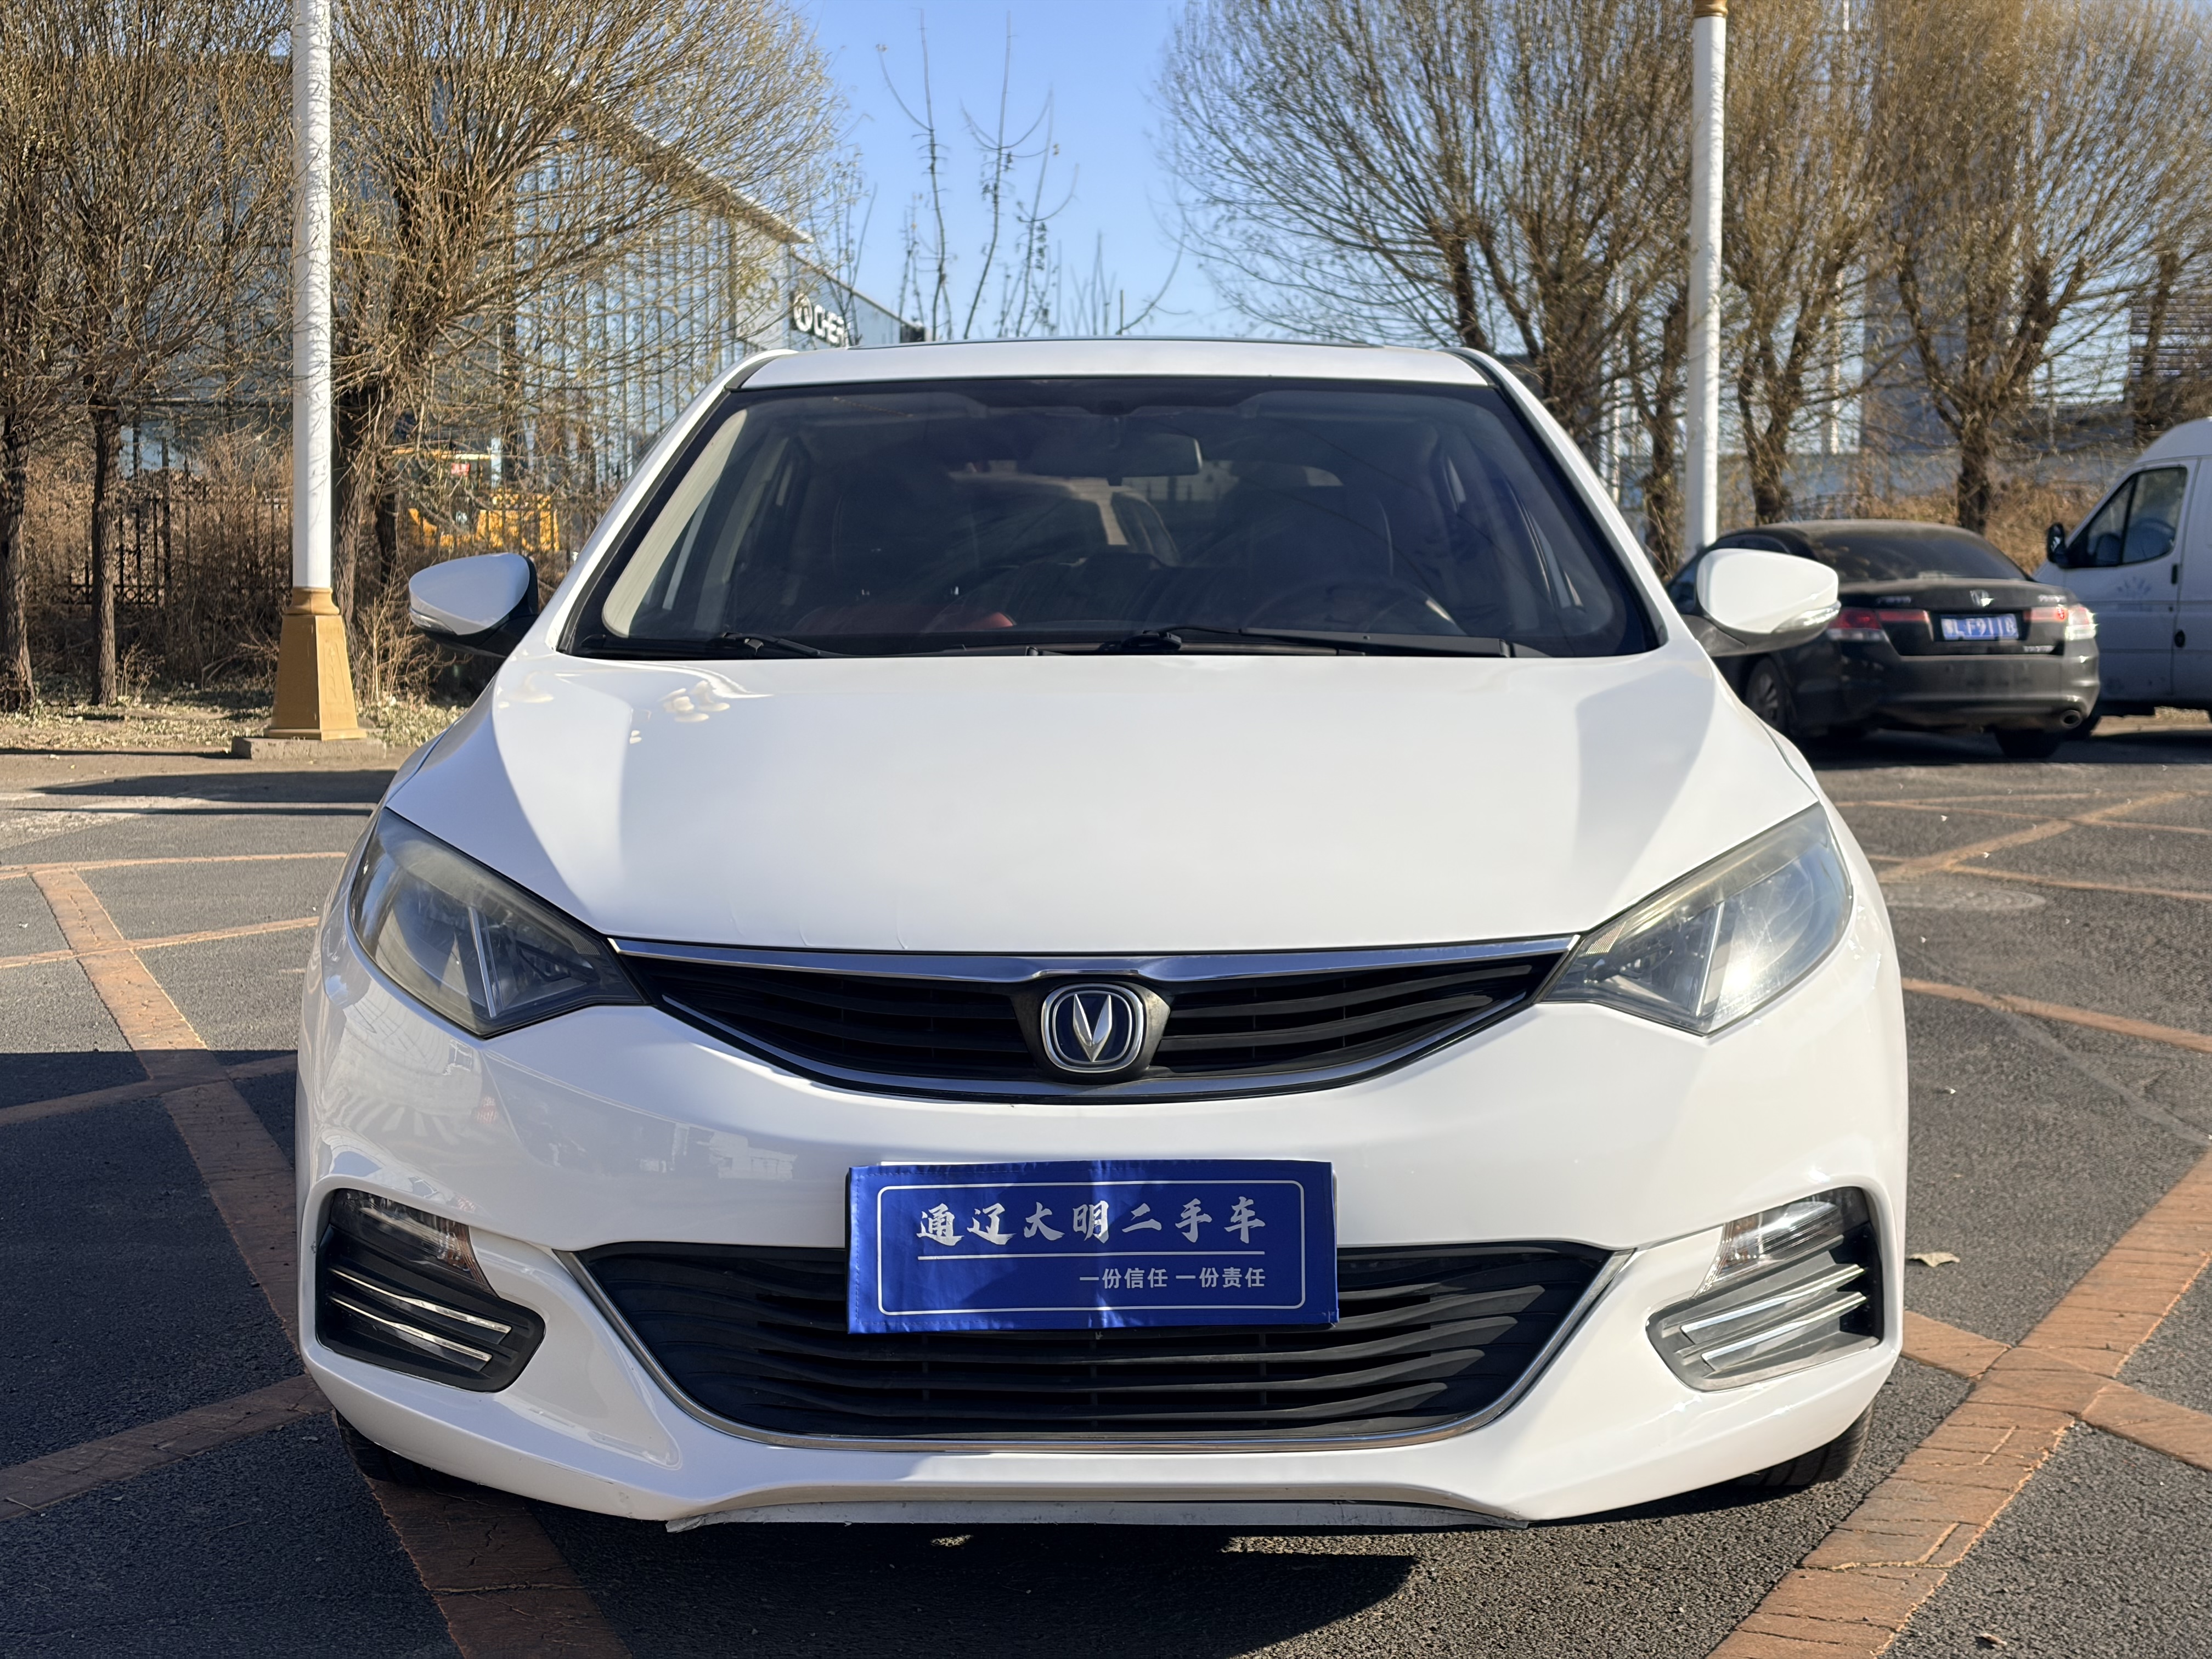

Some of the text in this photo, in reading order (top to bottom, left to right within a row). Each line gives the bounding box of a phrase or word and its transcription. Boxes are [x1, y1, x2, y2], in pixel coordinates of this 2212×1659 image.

[916, 1196, 1266, 1246] 通辽大明二手车
[1079, 1267, 1266, 1289] 一份信任 一份责任
